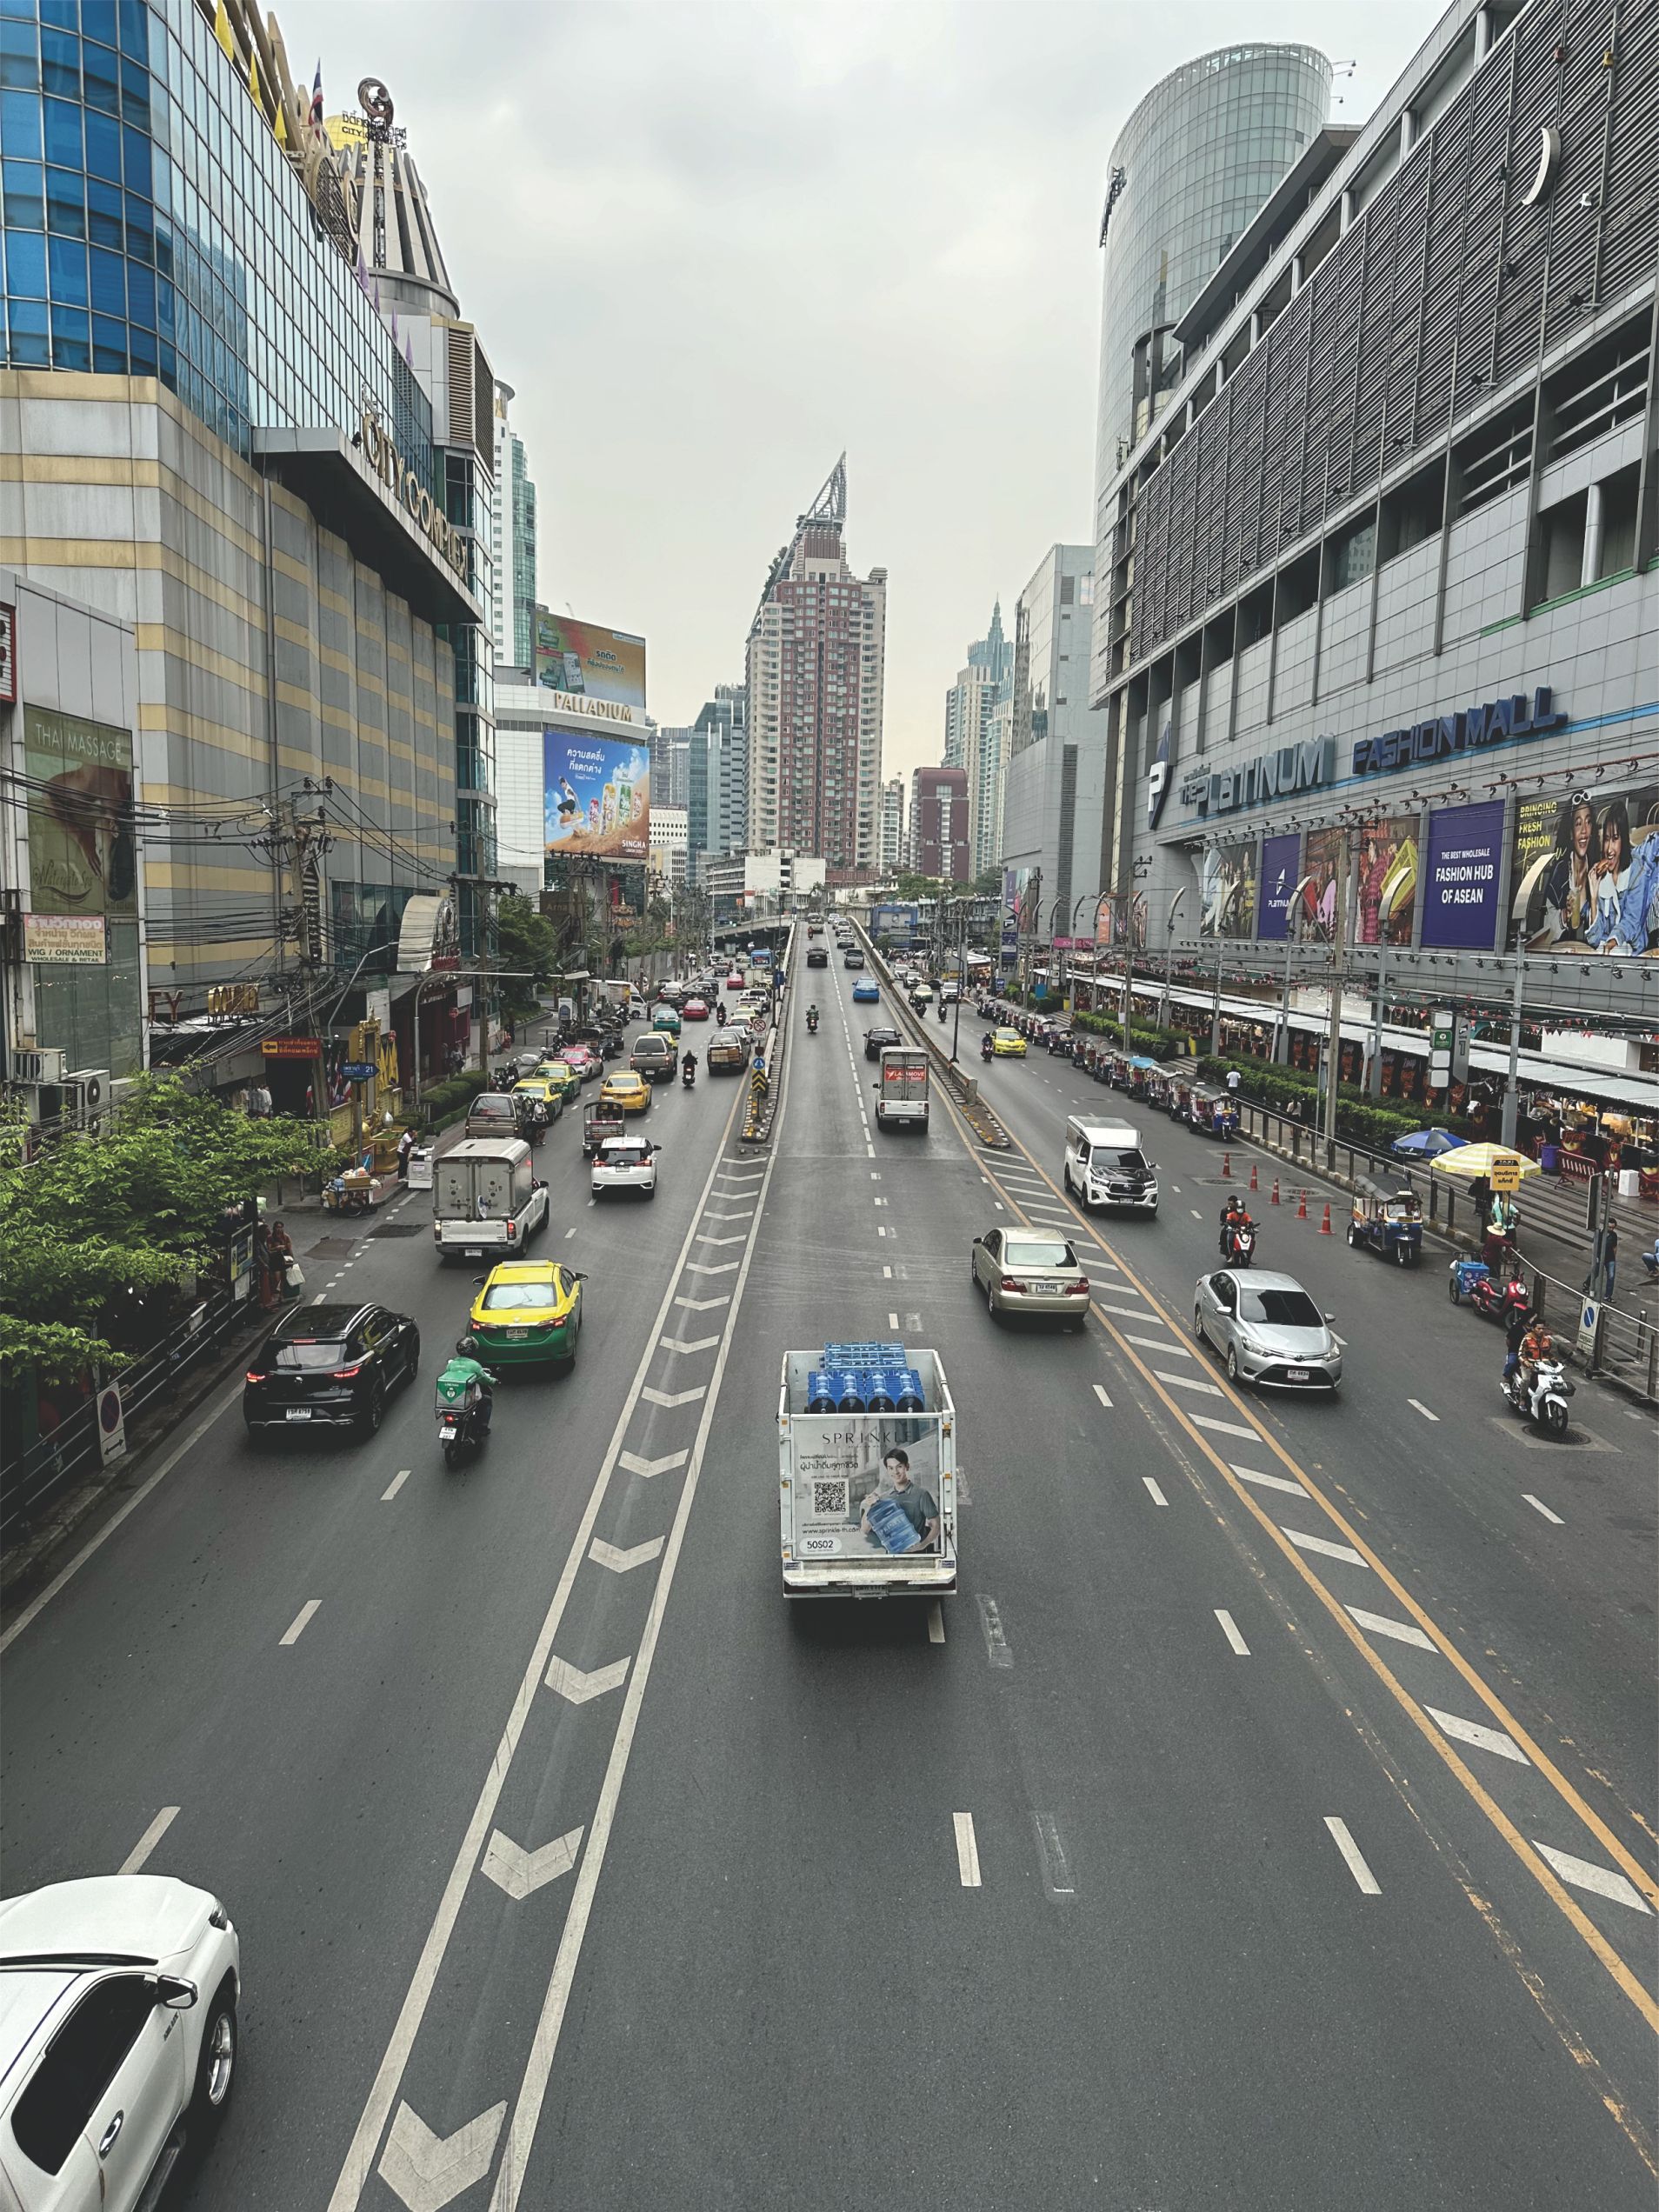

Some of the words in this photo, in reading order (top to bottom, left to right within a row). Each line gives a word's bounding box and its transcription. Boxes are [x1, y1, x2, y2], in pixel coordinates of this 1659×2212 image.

[342, 126, 363, 137] CITY
[363, 413, 404, 501] CITY
[555, 693, 632, 723] PALLADIUM
[1352, 713, 1466, 775] FASHION
[1465, 685, 1568, 746] MALL
[36, 723, 63, 750] THAI
[68, 733, 122, 762] MASSAGE
[567, 748, 605, 762] ความสดชื่น
[569, 759, 602, 774] ที่แตกต่าง
[1196, 734, 1335, 817] PLATINUM
[1520, 801, 1557, 818] BRINGING
[1519, 820, 1542, 834] FRESH
[622, 839, 646, 849] SINGHA
[1517, 835, 1550, 849] FASHION
[1442, 851, 1450, 860] THE
[1450, 849, 1461, 859] BEST
[1462, 848, 1490, 858] WHOLESALE
[1436, 867, 1473, 882] FASHION
[1474, 864, 1493, 880] HUB
[1442, 889, 1453, 903] OF
[1454, 889, 1483, 903] ASEAN
[1268, 899, 1289, 908] PLATINU
[149, 990, 183, 1022] TY
[822, 1431, 913, 1445] SPRINKLE
[806, 1539, 834, 1549] 50S02
